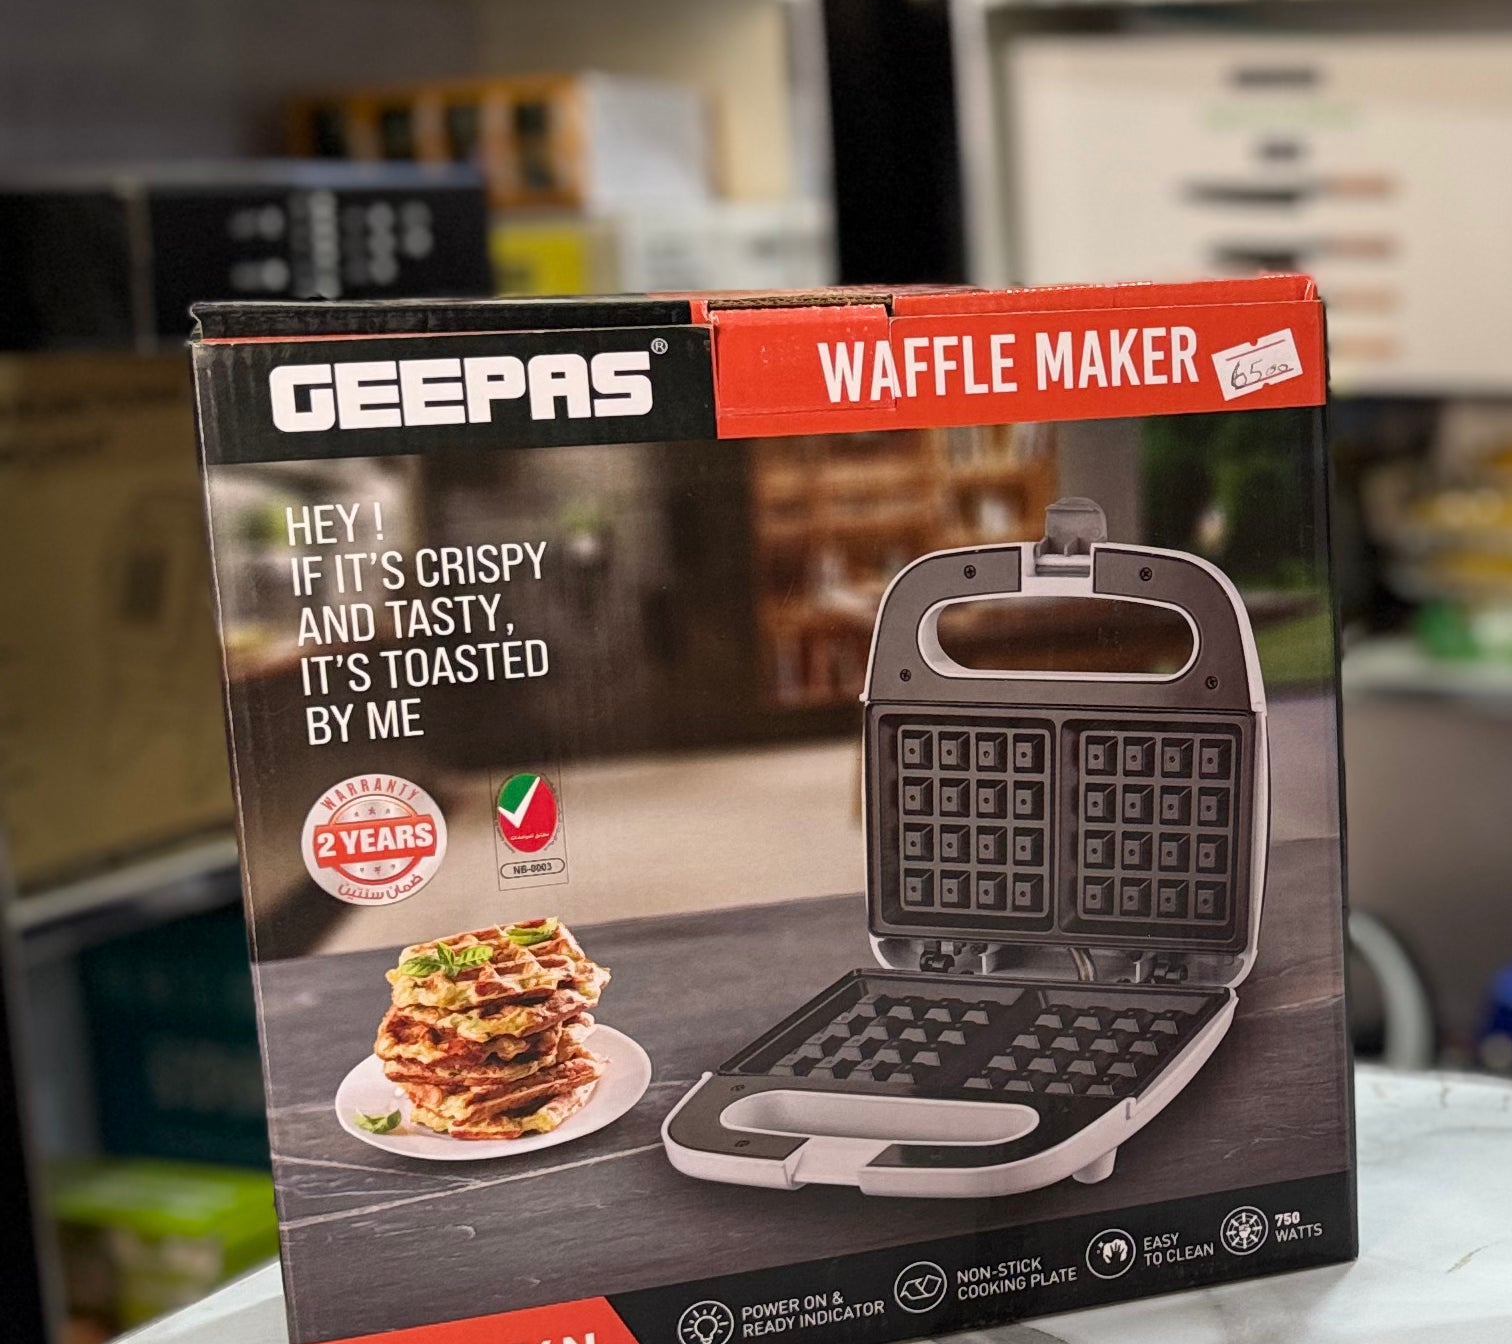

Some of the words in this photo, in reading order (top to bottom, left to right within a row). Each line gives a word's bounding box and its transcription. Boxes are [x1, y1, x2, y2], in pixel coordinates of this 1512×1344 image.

[817, 333, 1018, 403] WAFFLE
[1035, 326, 1199, 391] MAKER
[286, 502, 361, 546] HEY
[290, 556, 323, 596] IF
[334, 550, 405, 593] IT'S
[415, 541, 547, 588] CRISPY
[298, 603, 375, 647] AND
[301, 652, 371, 696] IT'S
[379, 639, 549, 689] TOASTED
[306, 704, 353, 746] BY
[366, 698, 424, 740] ME
[321, 777, 420, 811] WARRANTY
[317, 832, 337, 858] 2
[338, 822, 434, 855] YEARS
[338, 881, 385, 900] سنتين
[386, 873, 424, 899] ضمان
[1274, 1211, 1300, 1227] 750
[1275, 1223, 1323, 1242] WATTS
[1143, 1232, 1180, 1251] EASY
[1144, 1251, 1163, 1267] TO
[1166, 1242, 1214, 1263] CLEAN
[956, 1256, 1042, 1284] NON-STICK
[957, 1276, 1027, 1301] COOKING
[1030, 1266, 1078, 1288] PLATE
[741, 1297, 800, 1321] POWER
[804, 1292, 827, 1309] ON
[832, 1291, 844, 1305] &
[742, 1313, 796, 1338] READY
[799, 1300, 885, 1328] INDICATOR
